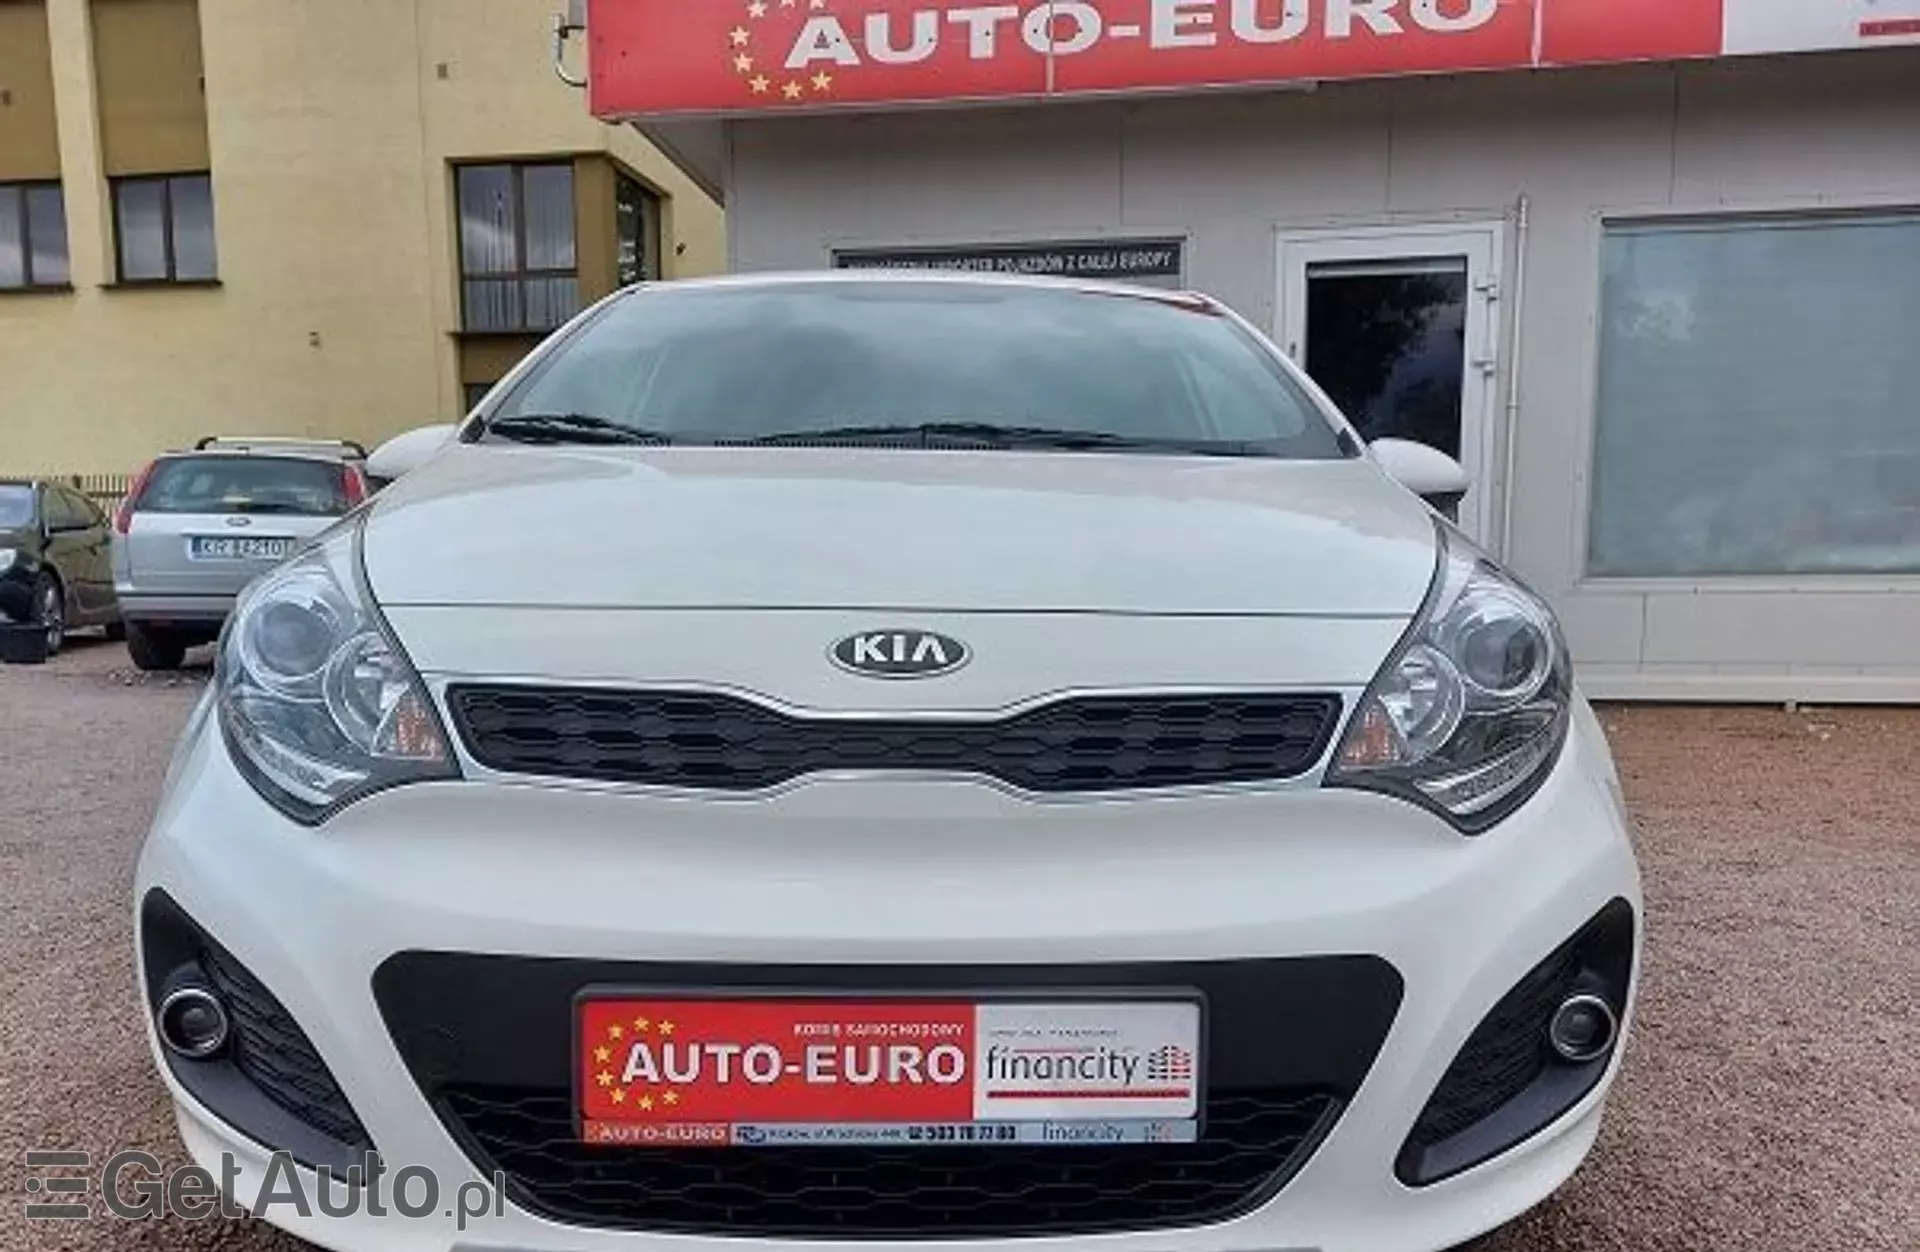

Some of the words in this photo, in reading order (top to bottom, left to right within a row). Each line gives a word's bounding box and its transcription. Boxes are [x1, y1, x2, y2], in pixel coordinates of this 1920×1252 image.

[785, 0, 1498, 67] AUTO-EURO
[854, 634, 948, 663] KIA
[621, 1041, 966, 1084] AUTO-EURO
[987, 1043, 1140, 1085] financity
[599, 1122, 726, 1141] AUTO-EURO
